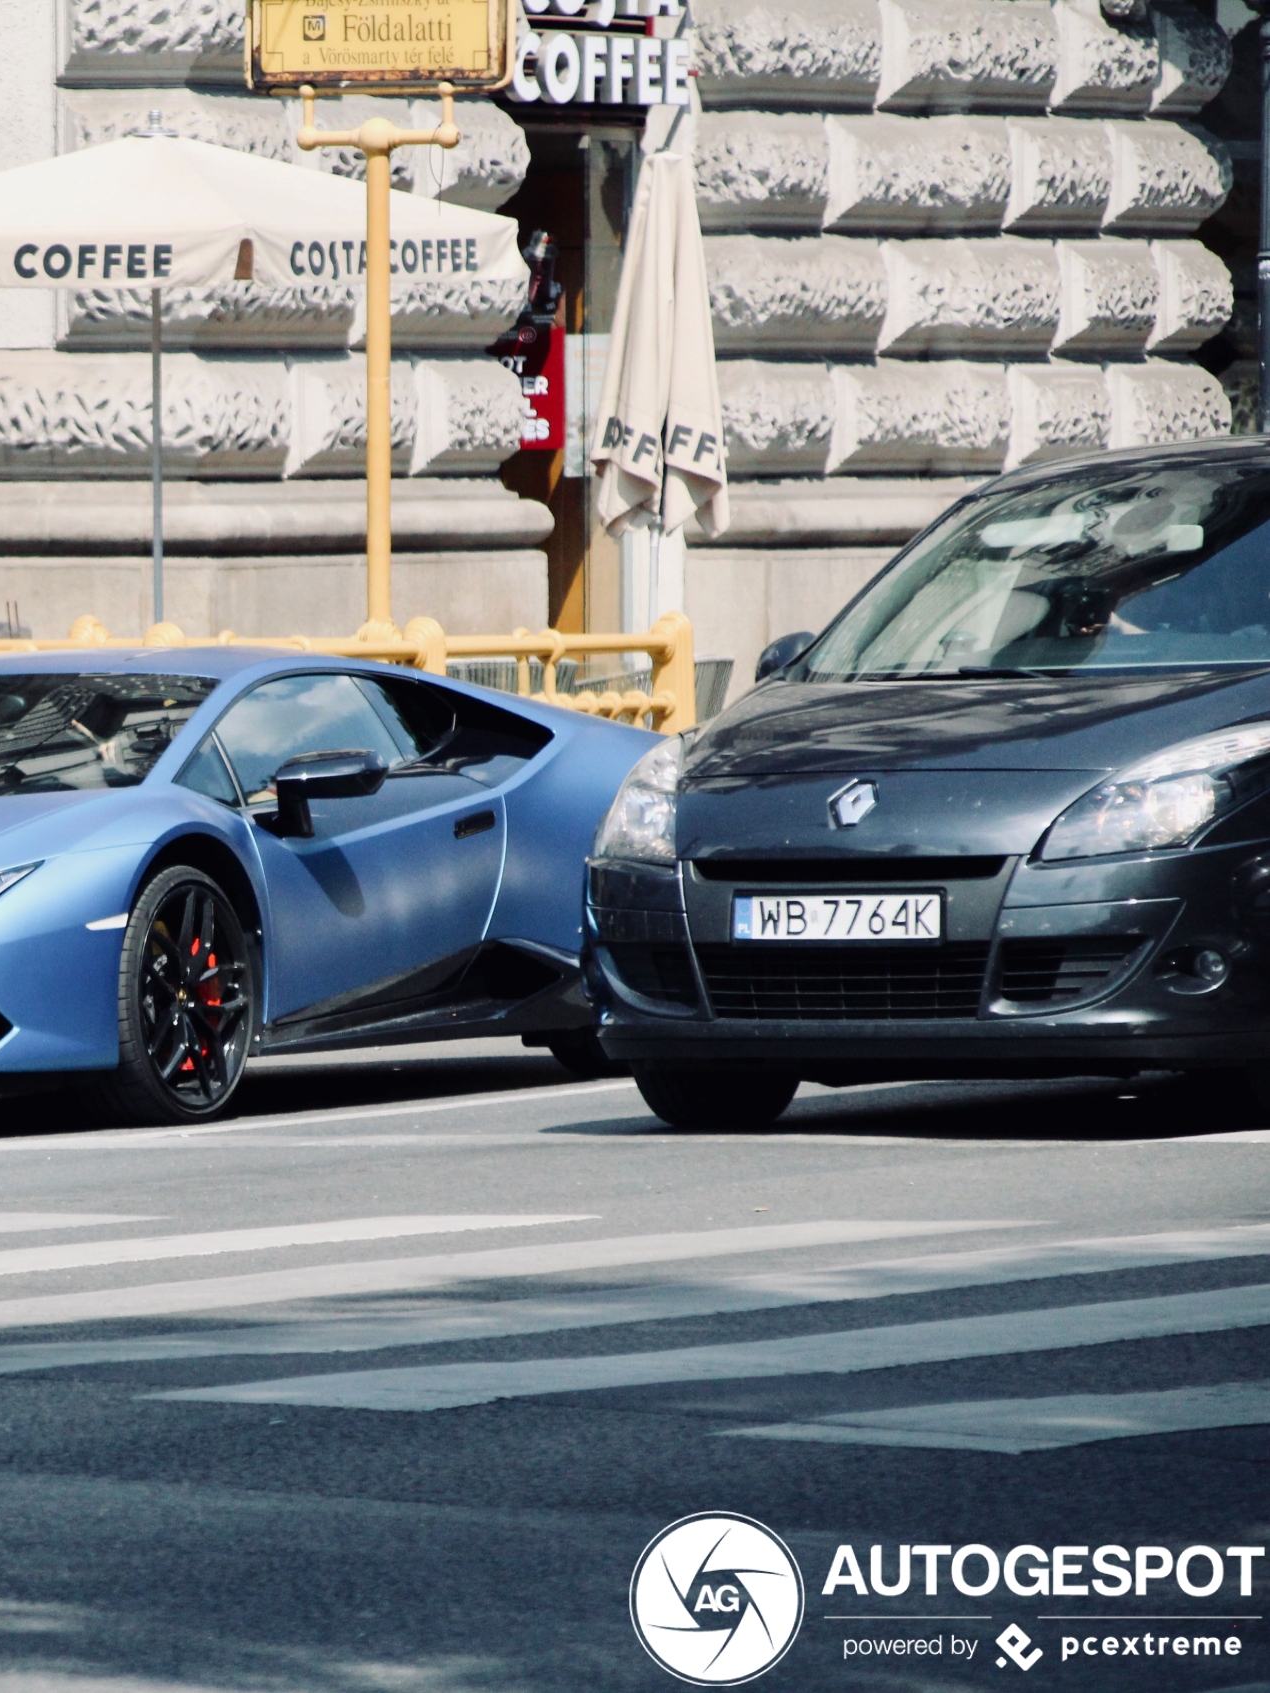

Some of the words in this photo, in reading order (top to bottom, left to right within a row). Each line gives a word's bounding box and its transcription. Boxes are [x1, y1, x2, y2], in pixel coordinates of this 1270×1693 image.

[342, 14, 453, 42] Földalatti
[302, 54, 310, 65] a
[318, 47, 399, 69] Vörösmarty
[404, 47, 422, 64] tér
[428, 46, 454, 64] felé
[512, 31, 690, 104] COFFEE
[14, 243, 173, 279] COFFEE
[389, 238, 479, 274] COFFEE
[737, 924, 751, 934] PL
[759, 900, 808, 936] WB
[823, 900, 935, 936] 7764K
